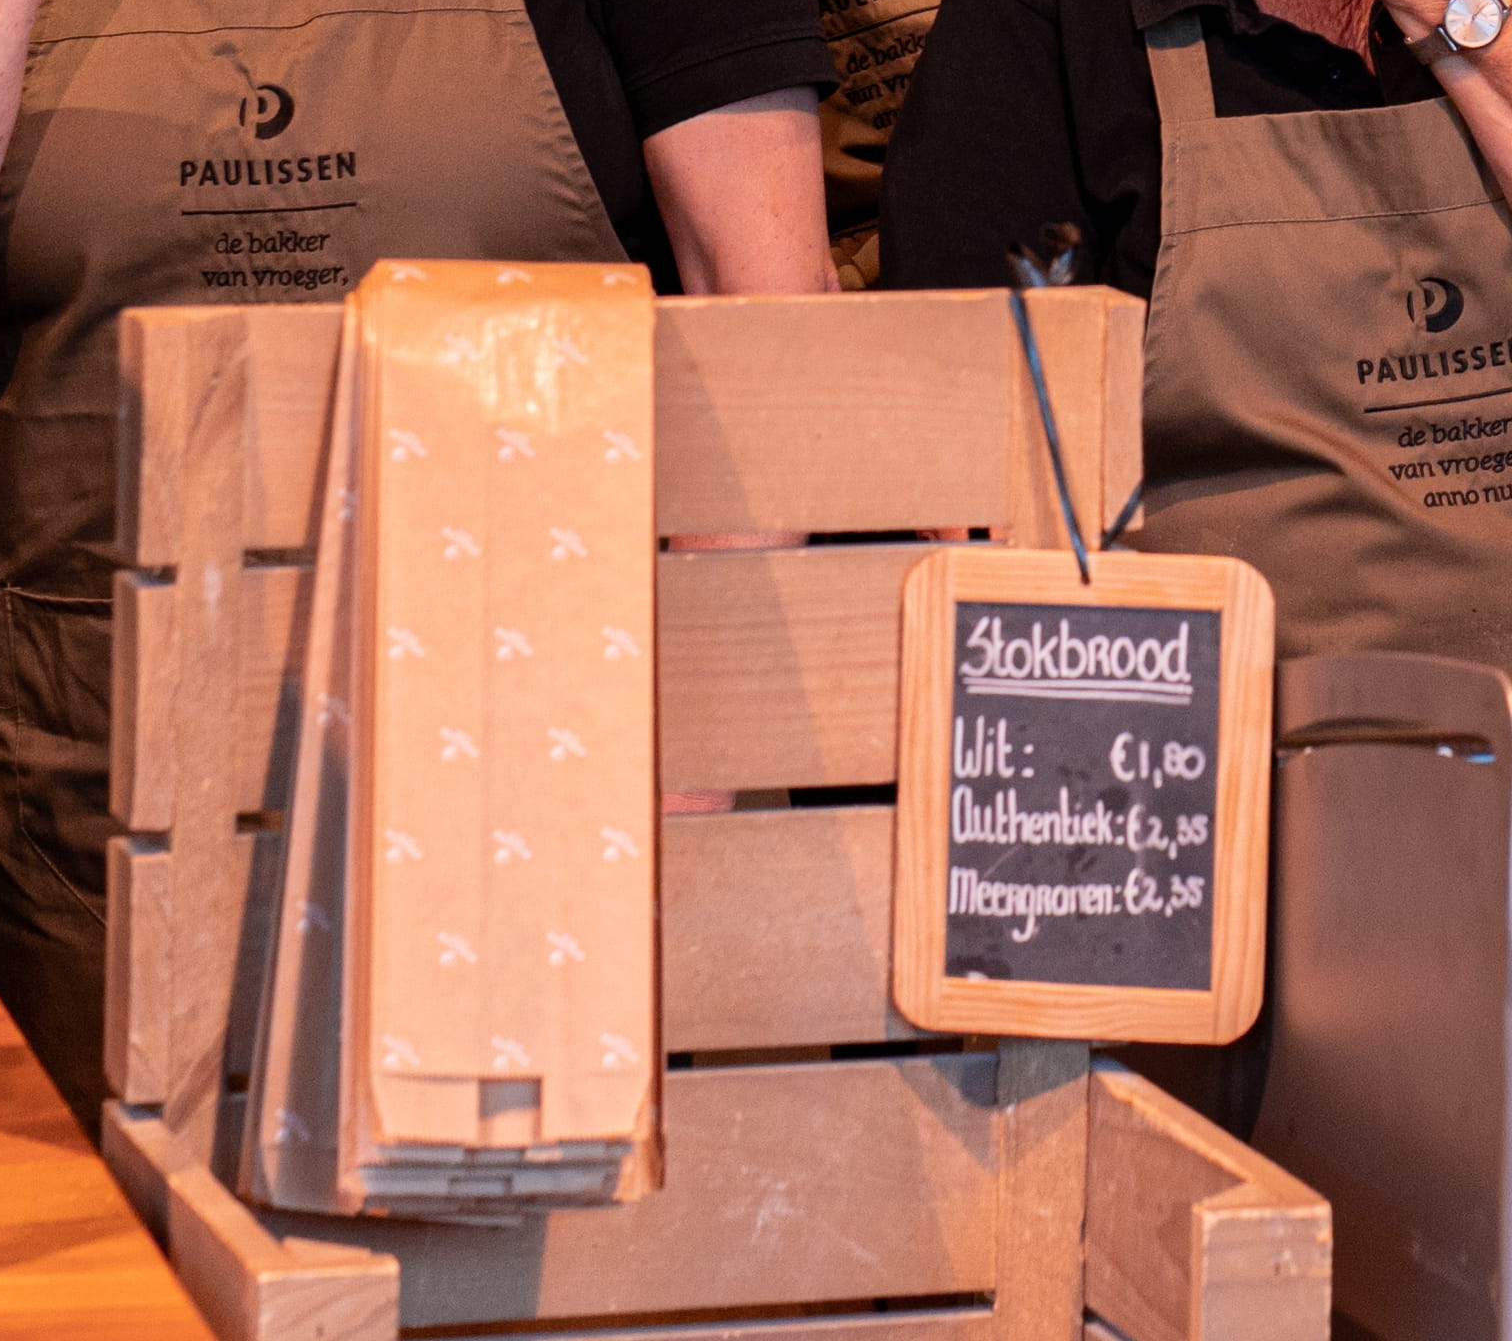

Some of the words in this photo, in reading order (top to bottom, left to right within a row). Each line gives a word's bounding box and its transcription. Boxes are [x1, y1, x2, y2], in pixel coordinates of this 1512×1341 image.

[846, 53, 871, 74] de
[872, 33, 926, 66] bakk
[180, 152, 356, 186] PAULISSEN
[214, 232, 243, 255] de
[247, 231, 330, 254] bakker
[201, 270, 248, 287] van
[252, 267, 349, 291] vroeger,
[1398, 426, 1426, 448] de
[1432, 417, 1512, 444] bakker
[1389, 462, 1436, 481] van
[1424, 489, 1479, 508] anno
[960, 615, 1193, 684] Stokbrood
